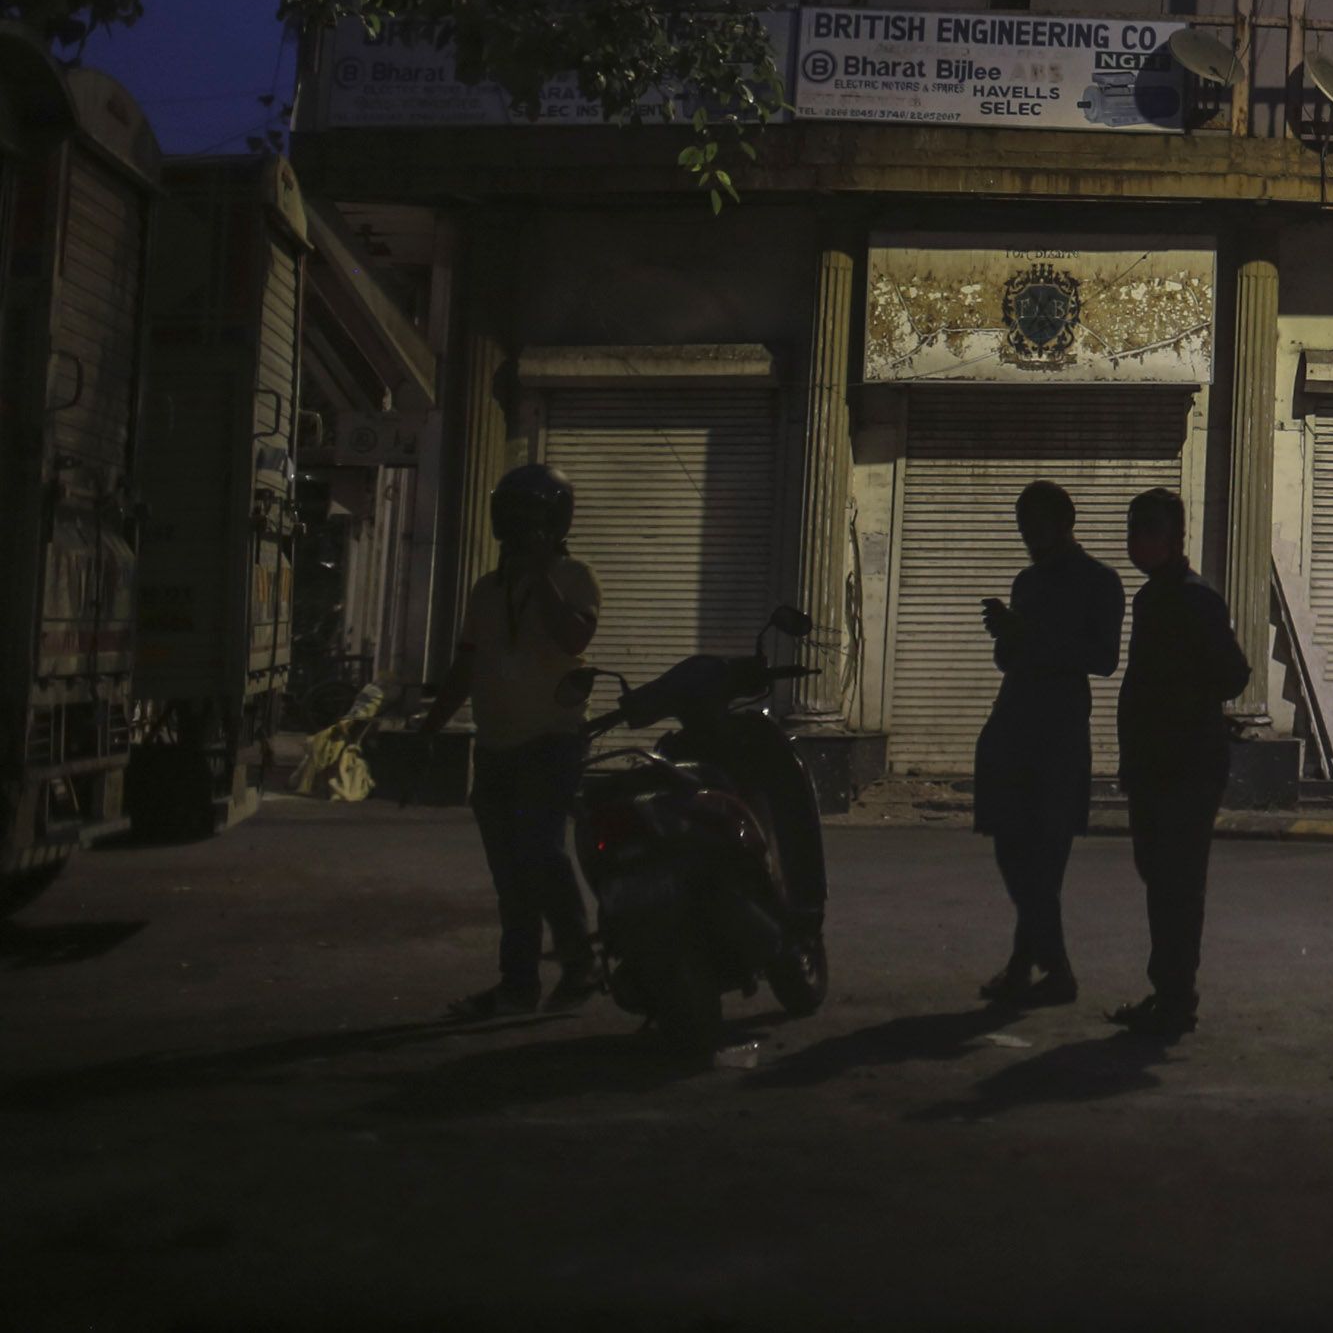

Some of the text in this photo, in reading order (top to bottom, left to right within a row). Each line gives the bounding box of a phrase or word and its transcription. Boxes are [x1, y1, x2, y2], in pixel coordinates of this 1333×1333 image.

[813, 12, 926, 42] BRITISH
[936, 18, 1110, 50] ENGINEERING
[1121, 24, 1157, 51] CO
[371, 61, 446, 83] Bharat
[843, 55, 927, 79] Bharat
[935, 58, 1002, 84] Bijlee
[834, 78, 880, 91] ELECTRIC
[880, 80, 920, 93] MOTORS
[930, 81, 966, 95] SPARES
[972, 85, 1061, 100] HAVELLS
[979, 100, 1043, 117] SELEC
